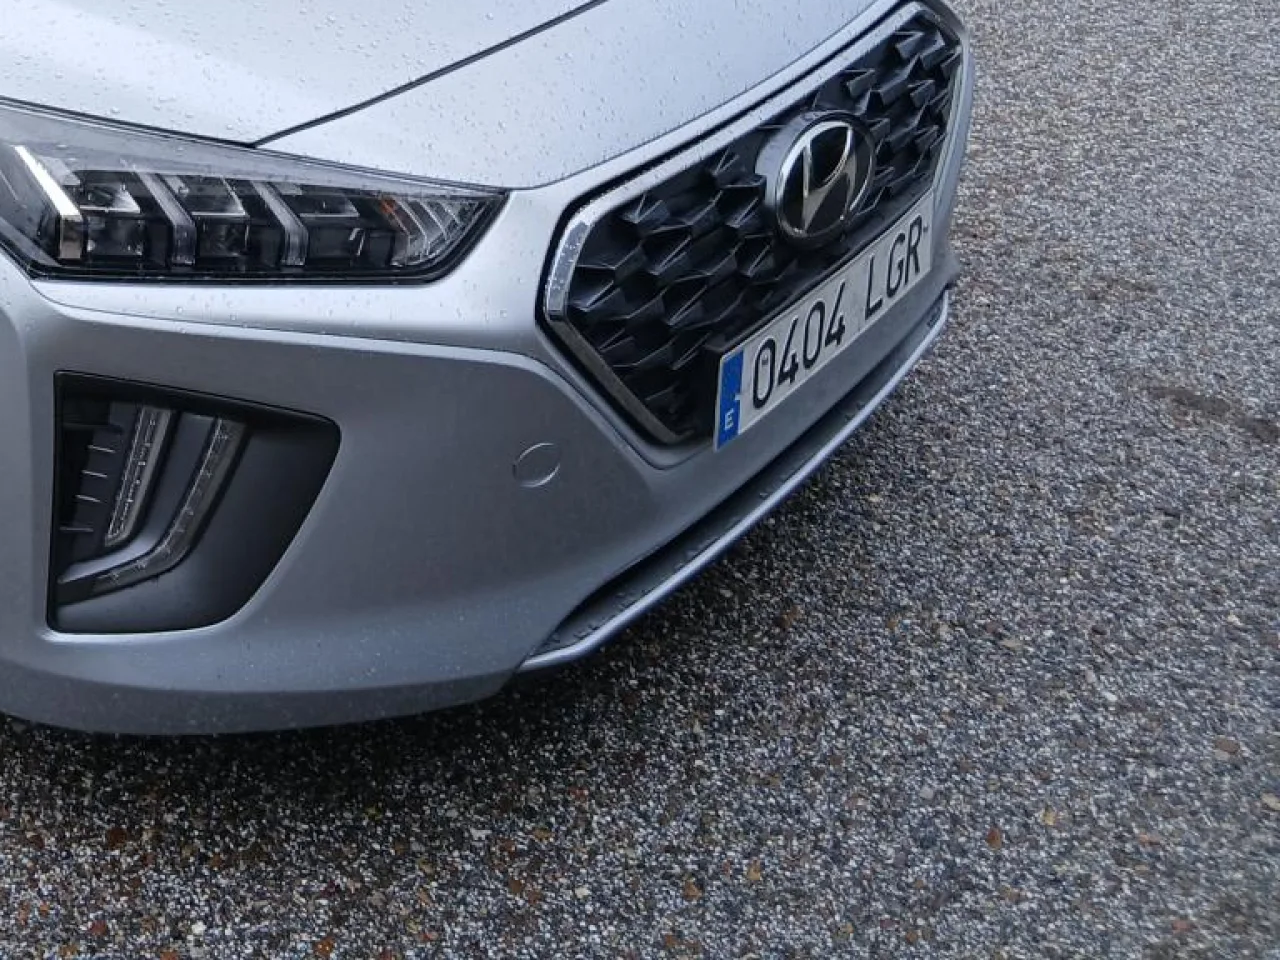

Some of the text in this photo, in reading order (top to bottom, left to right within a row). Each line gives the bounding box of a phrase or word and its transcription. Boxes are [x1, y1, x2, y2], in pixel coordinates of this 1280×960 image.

[752, 215, 923, 409] 0404 LGR
[724, 408, 735, 431] E
